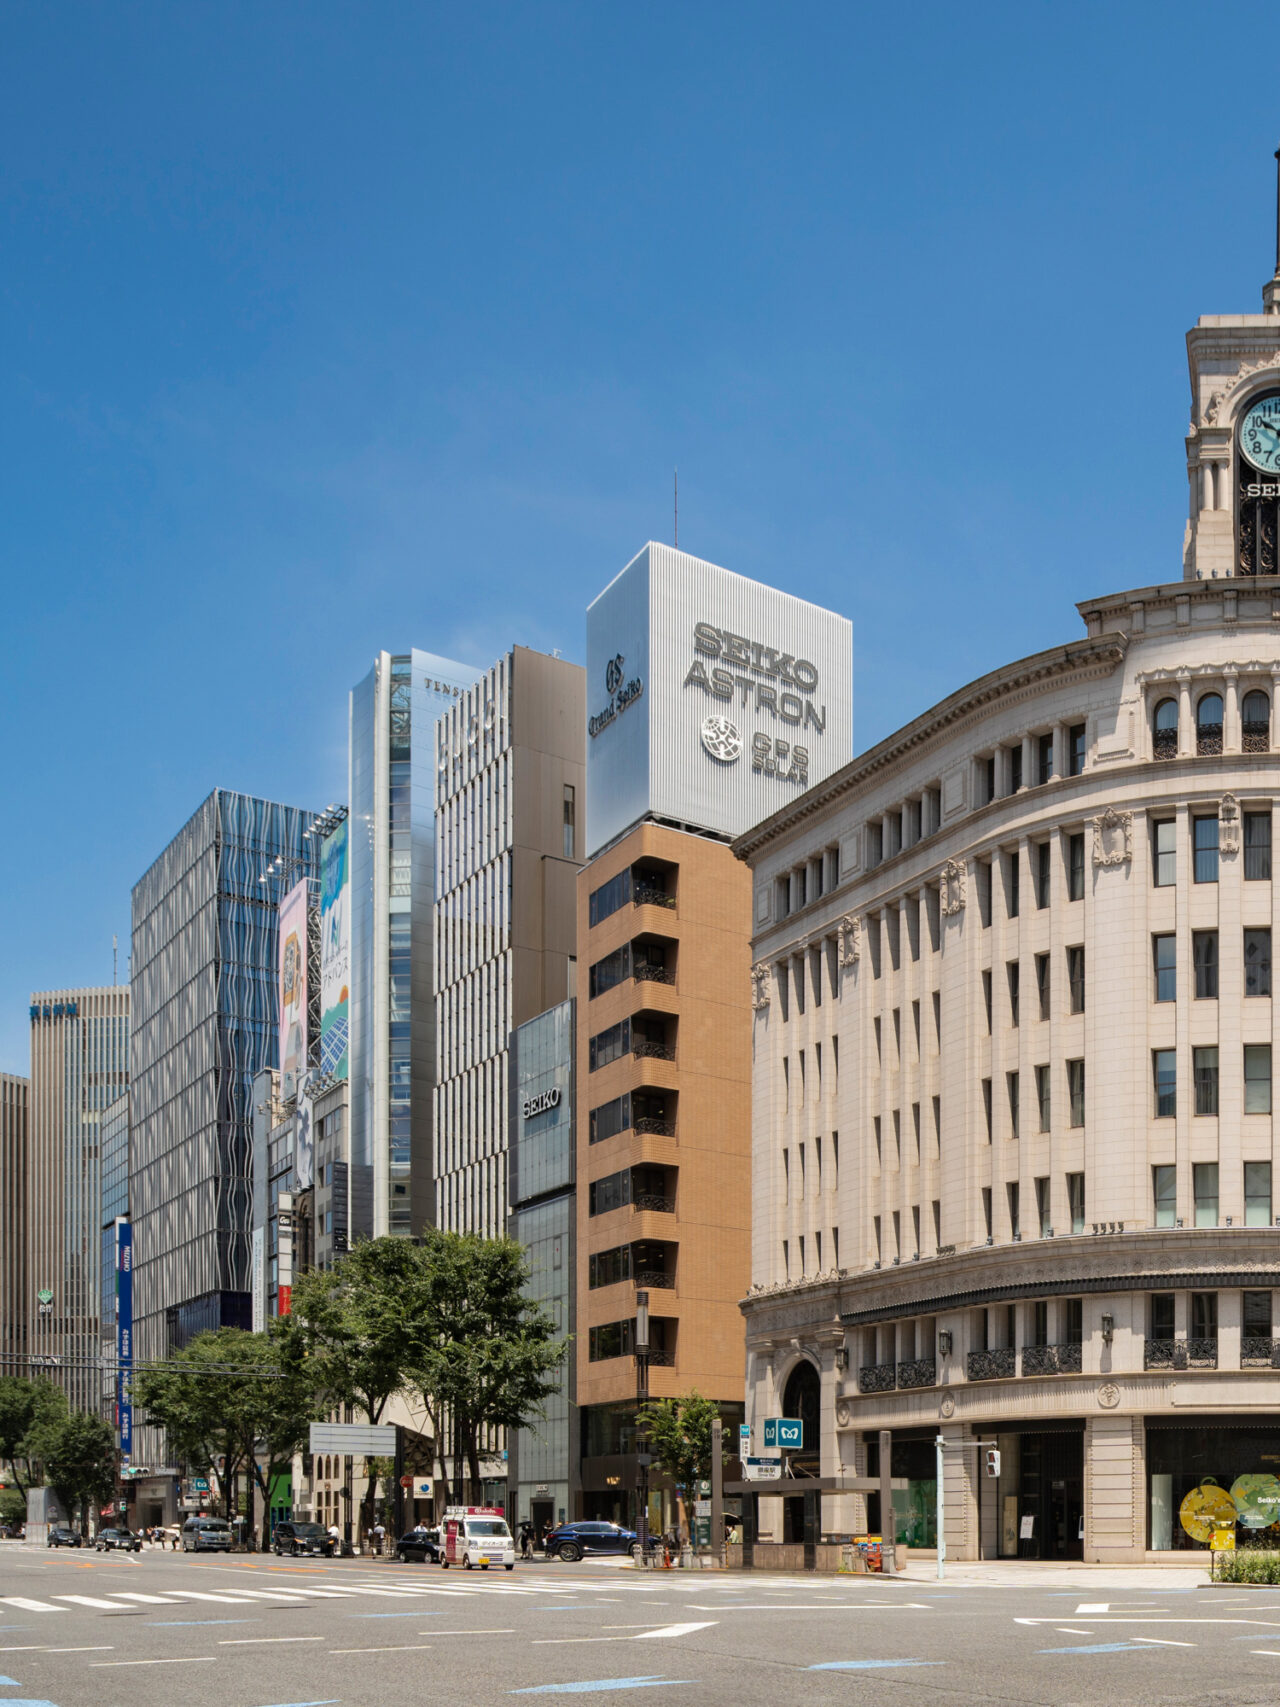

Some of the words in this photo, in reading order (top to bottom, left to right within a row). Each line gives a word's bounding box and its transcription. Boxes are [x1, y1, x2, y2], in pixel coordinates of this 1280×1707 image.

[1252, 416, 1262, 428] 10
[1263, 405, 1272, 418] 11
[1248, 429, 1257, 441] 9
[1252, 442, 1262, 454] 8
[1264, 451, 1273, 463] 7
[694, 621, 818, 690] SEIKO
[588, 698, 617, 737] Grand
[617, 675, 644, 713] Seiko
[683, 659, 826, 731] ASTRON
[751, 731, 809, 767] GPS
[751, 755, 809, 784] SOLAR
[523, 1087, 560, 1119] SEIKO
